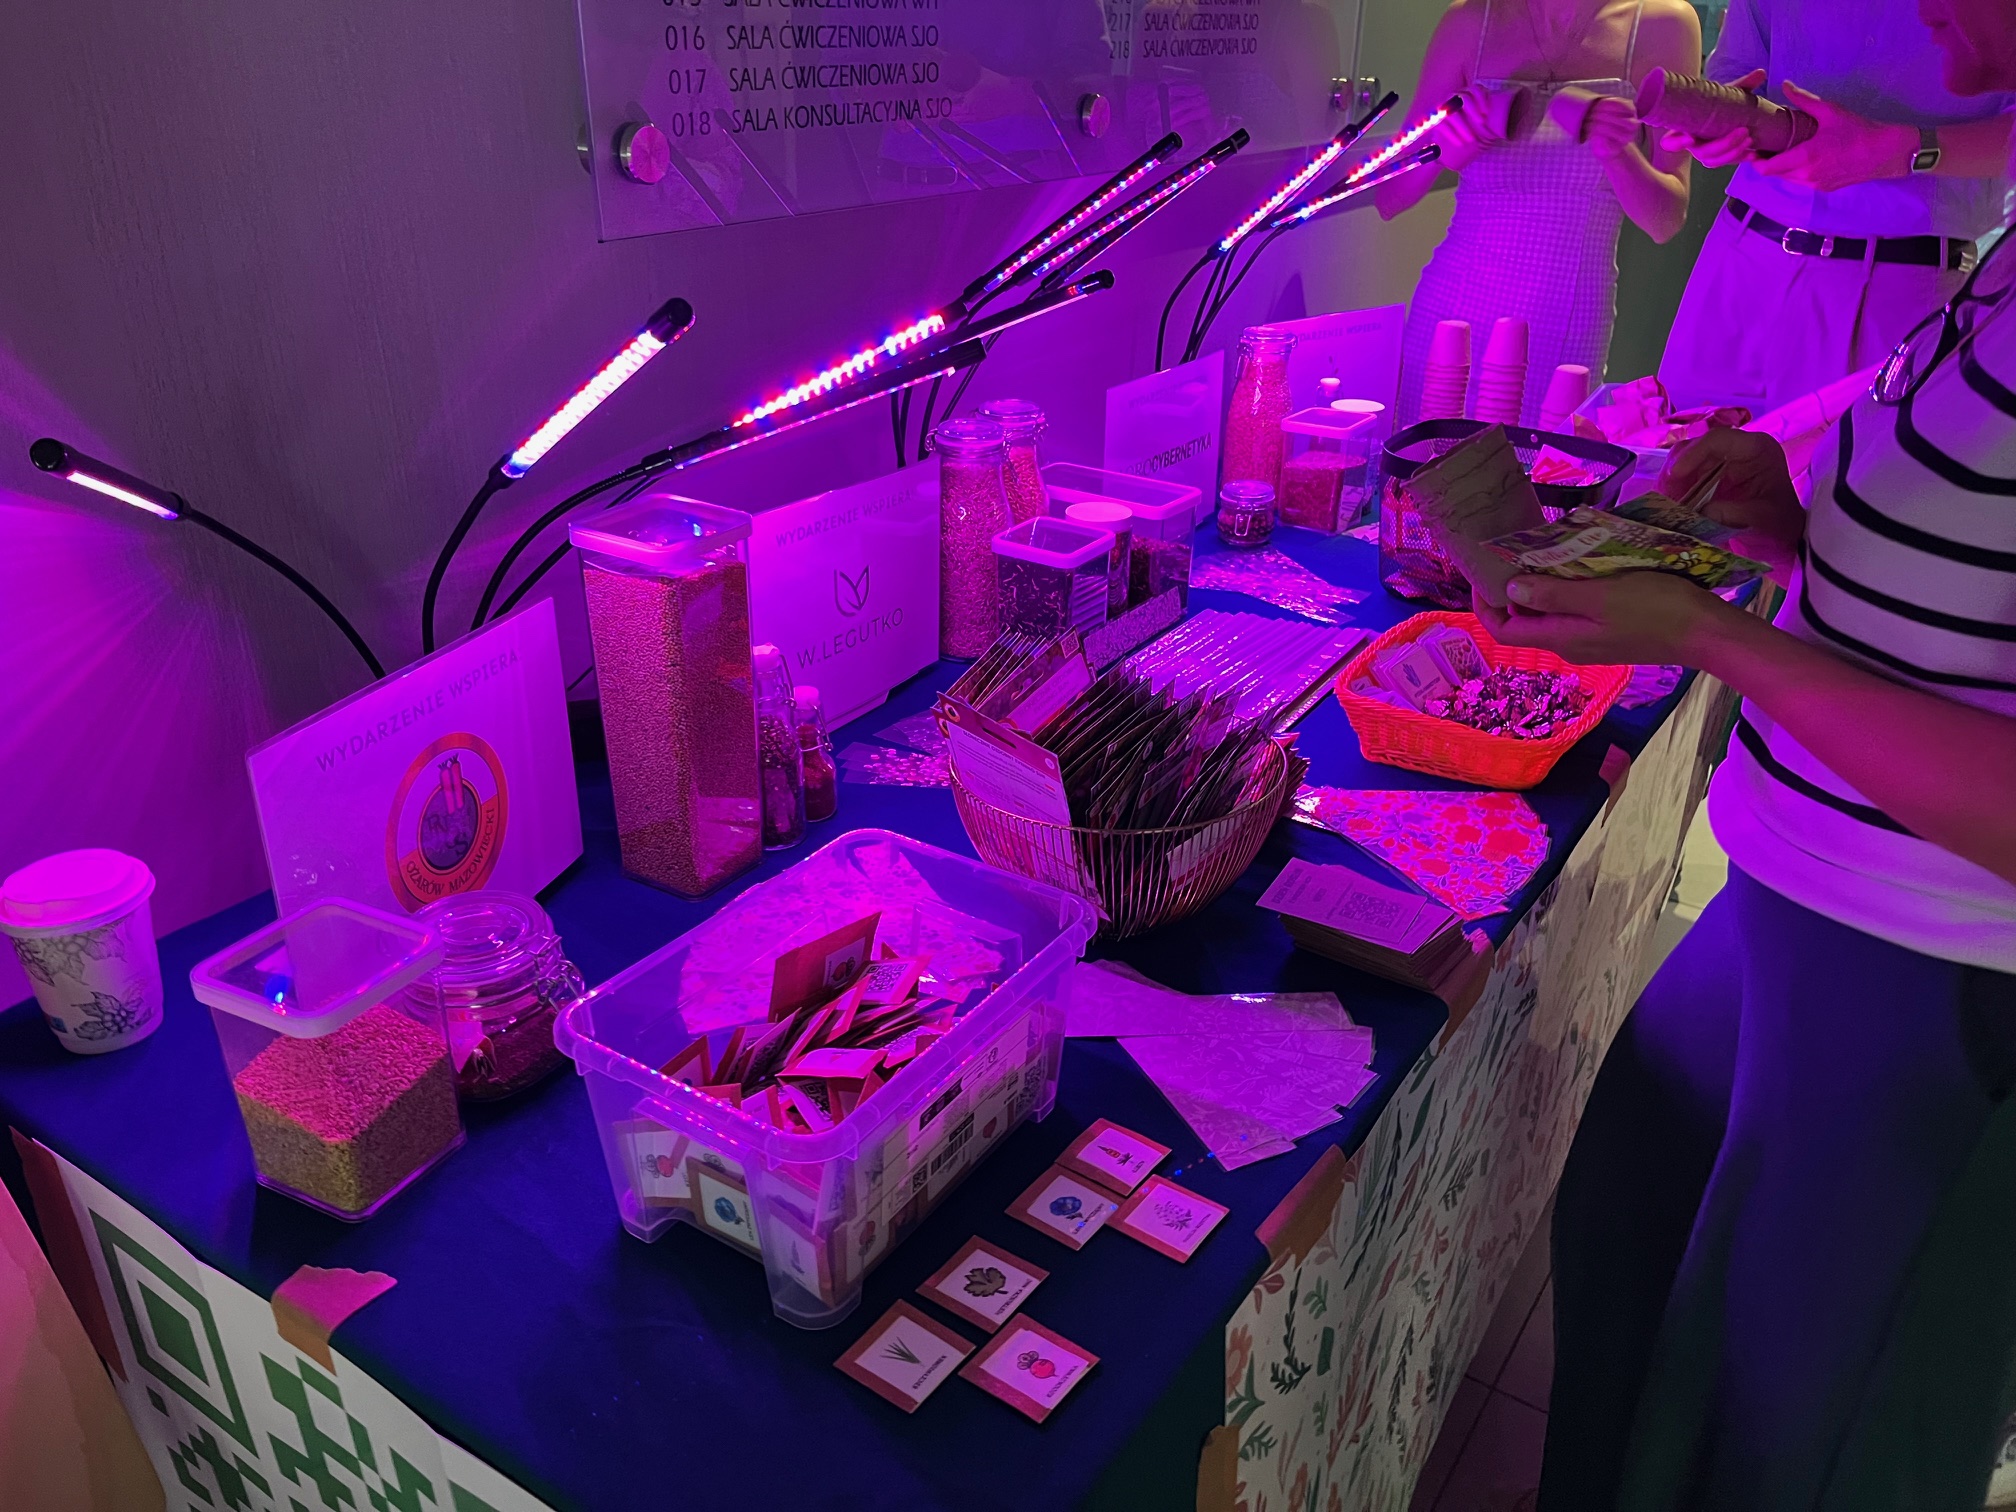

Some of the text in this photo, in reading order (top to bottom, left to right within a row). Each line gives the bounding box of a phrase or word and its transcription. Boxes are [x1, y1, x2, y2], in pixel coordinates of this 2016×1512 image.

[665, 19, 940, 51] 016 SALA ĆWICZENIOWA SJO
[1110, 13, 1131, 32] 217
[1143, 12, 1169, 31] SALA
[1242, 12, 1260, 31] SJO
[1109, 40, 1130, 60] 218
[1142, 39, 1168, 59] SALA
[1240, 36, 1258, 56] SJO
[668, 60, 940, 95] 017 SALA ĆWICZENIOWA SJO
[672, 97, 953, 138] 018 SALA KONSULTACYJNA SJO
[775, 489, 915, 549] WYDARZENIE WSPIERA
[796, 607, 905, 670] W.LEGUTKO
[314, 647, 519, 773] WYDARZENIE WSPIERA
[405, 859, 445, 896] OŻARÓW
[449, 807, 496, 894] MAZOWIECKI
